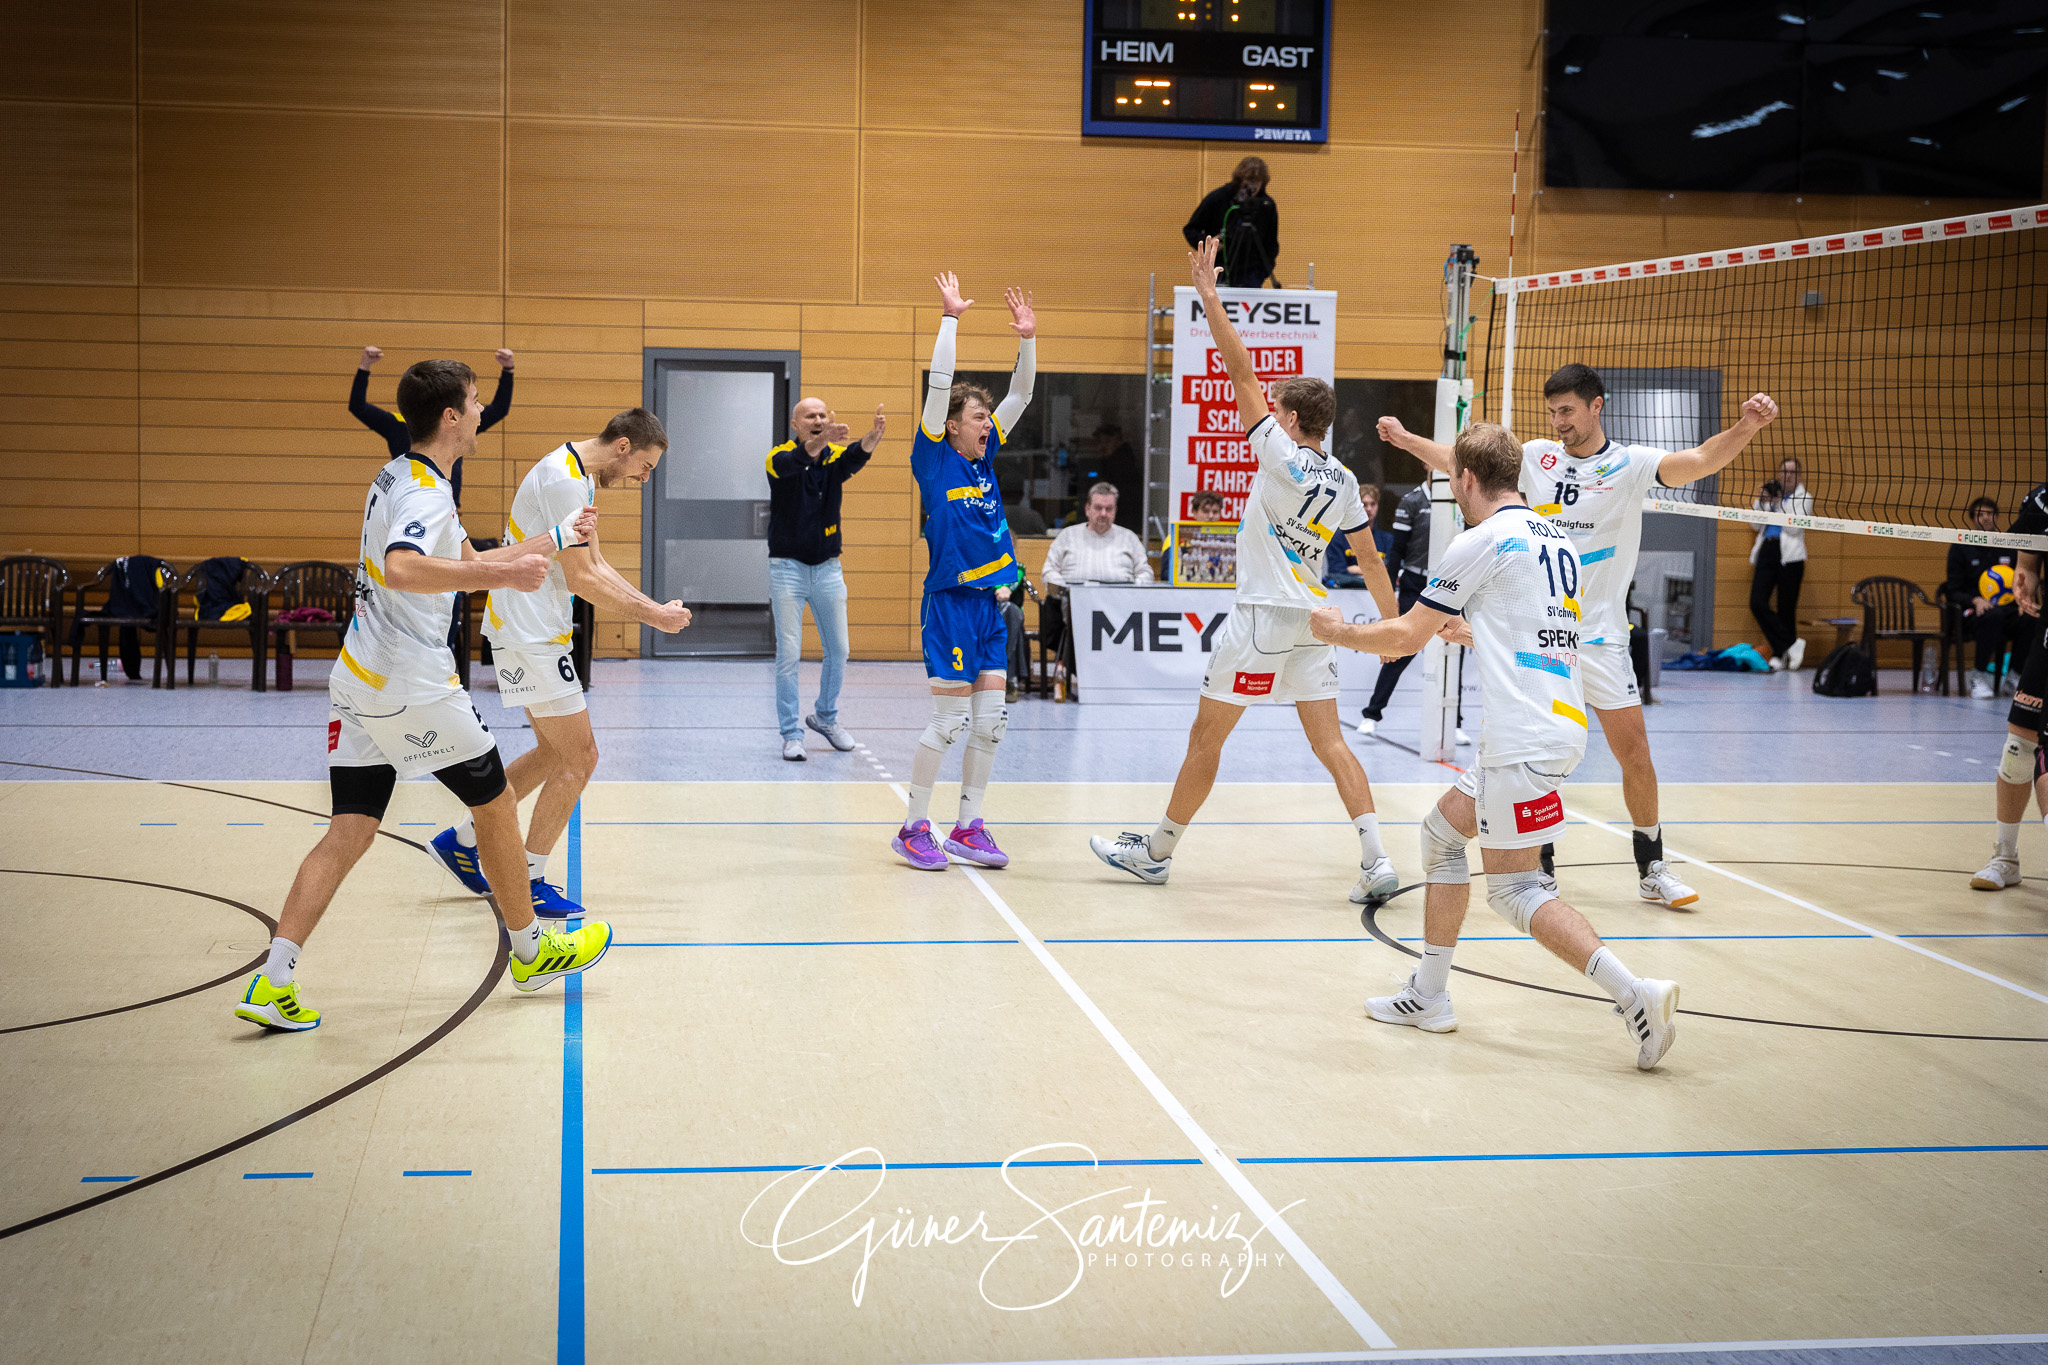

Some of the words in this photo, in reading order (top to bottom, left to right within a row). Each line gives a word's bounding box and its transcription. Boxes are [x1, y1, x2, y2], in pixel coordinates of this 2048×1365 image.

[1101, 40, 1174, 63] HEIM
[1242, 45, 1314, 68] GAST
[1254, 128, 1311, 141] PEWETA
[1240, 330, 1318, 340] Werbetechnik
[1554, 481, 1580, 506] 16
[1297, 484, 1336, 525] 17
[1286, 517, 1296, 527] SV
[1296, 522, 1321, 540] Schwaig
[1526, 520, 1565, 539] ROLL
[1556, 519, 1594, 530] Daigfuss
[1793, 518, 1811, 527] FUCHS
[1873, 525, 1893, 535] FUCHS
[1964, 534, 1987, 544] FUCHS
[1992, 535, 2006, 545] Ideen
[2006, 537, 2032, 548] umsetzen
[1538, 544, 1577, 599] 10
[1436, 579, 1460, 592] puls
[1092, 610, 1228, 652] MEY
[952, 647, 964, 671] 3
[557, 655, 575, 682] 6
[403, 745, 456, 762] OFFICEWELT
[1533, 802, 1558, 816] Sparkasse
[1535, 810, 1559, 823] Nürnberg
